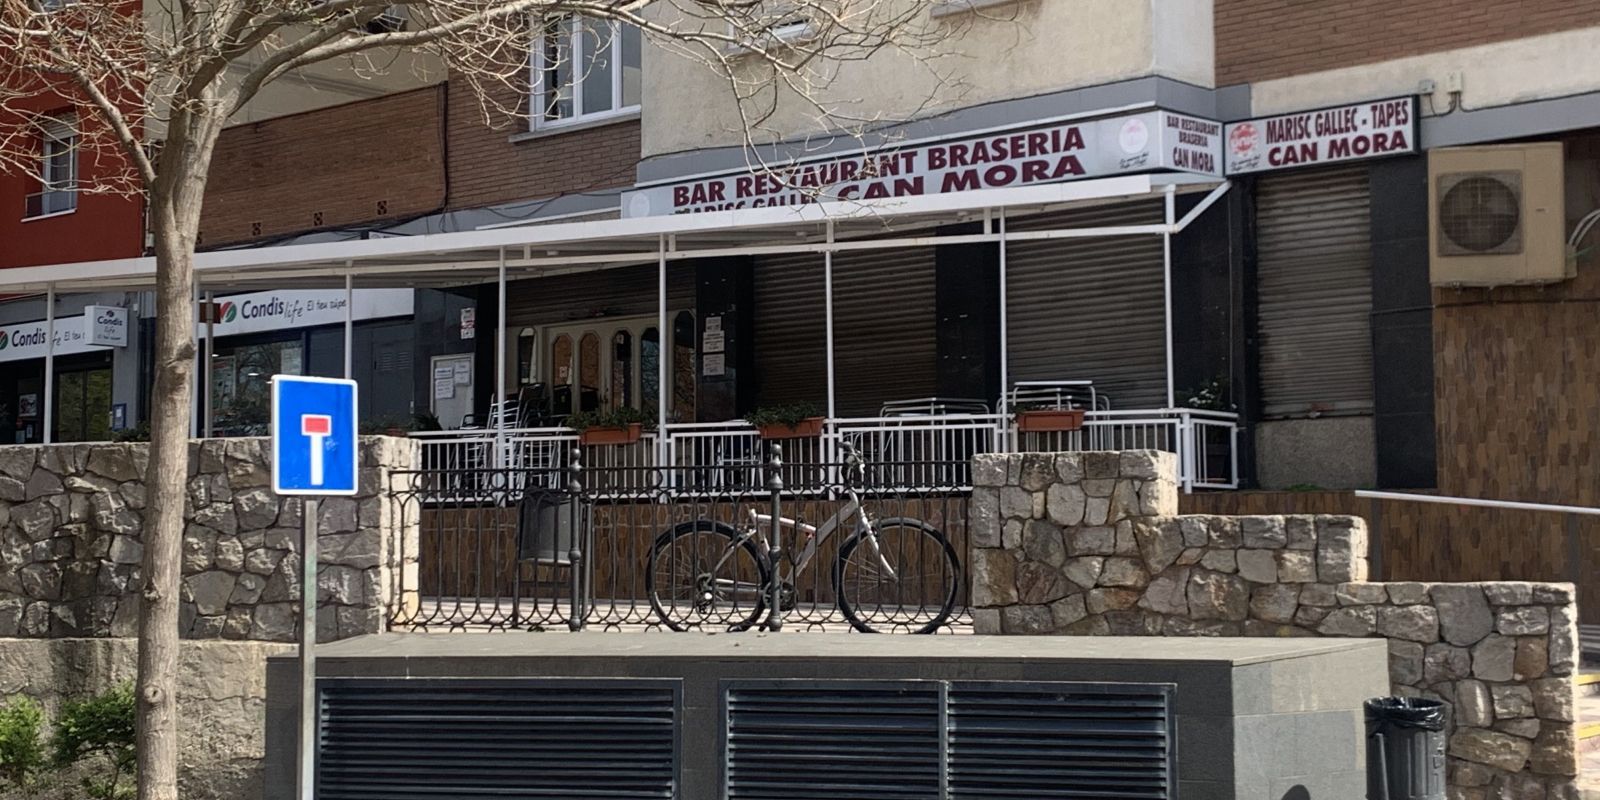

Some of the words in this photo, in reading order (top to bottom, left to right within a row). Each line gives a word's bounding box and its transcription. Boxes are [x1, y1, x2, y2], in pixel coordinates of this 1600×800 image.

[1167, 115, 1179, 128] BAR
[1181, 118, 1219, 136] RESTAURANT
[1266, 115, 1311, 144] MARISC
[1315, 108, 1358, 137] GALLEC
[1371, 100, 1409, 130] TAPES
[1179, 131, 1208, 148] BRASERIA
[1268, 142, 1318, 167] CAN
[1328, 130, 1408, 159] MORA
[674, 181, 725, 207] BAR
[736, 151, 917, 198] RESTAURANT
[928, 127, 1085, 171] BRASERIA
[1173, 146, 1189, 168] CAN
[1191, 150, 1215, 173] MORA
[837, 176, 924, 201] CAN
[941, 155, 1086, 193] MORA
[97, 316, 123, 326] Condis
[241, 297, 284, 319] Condis
[284, 300, 303, 323] life
[12, 328, 46, 347] Condis
